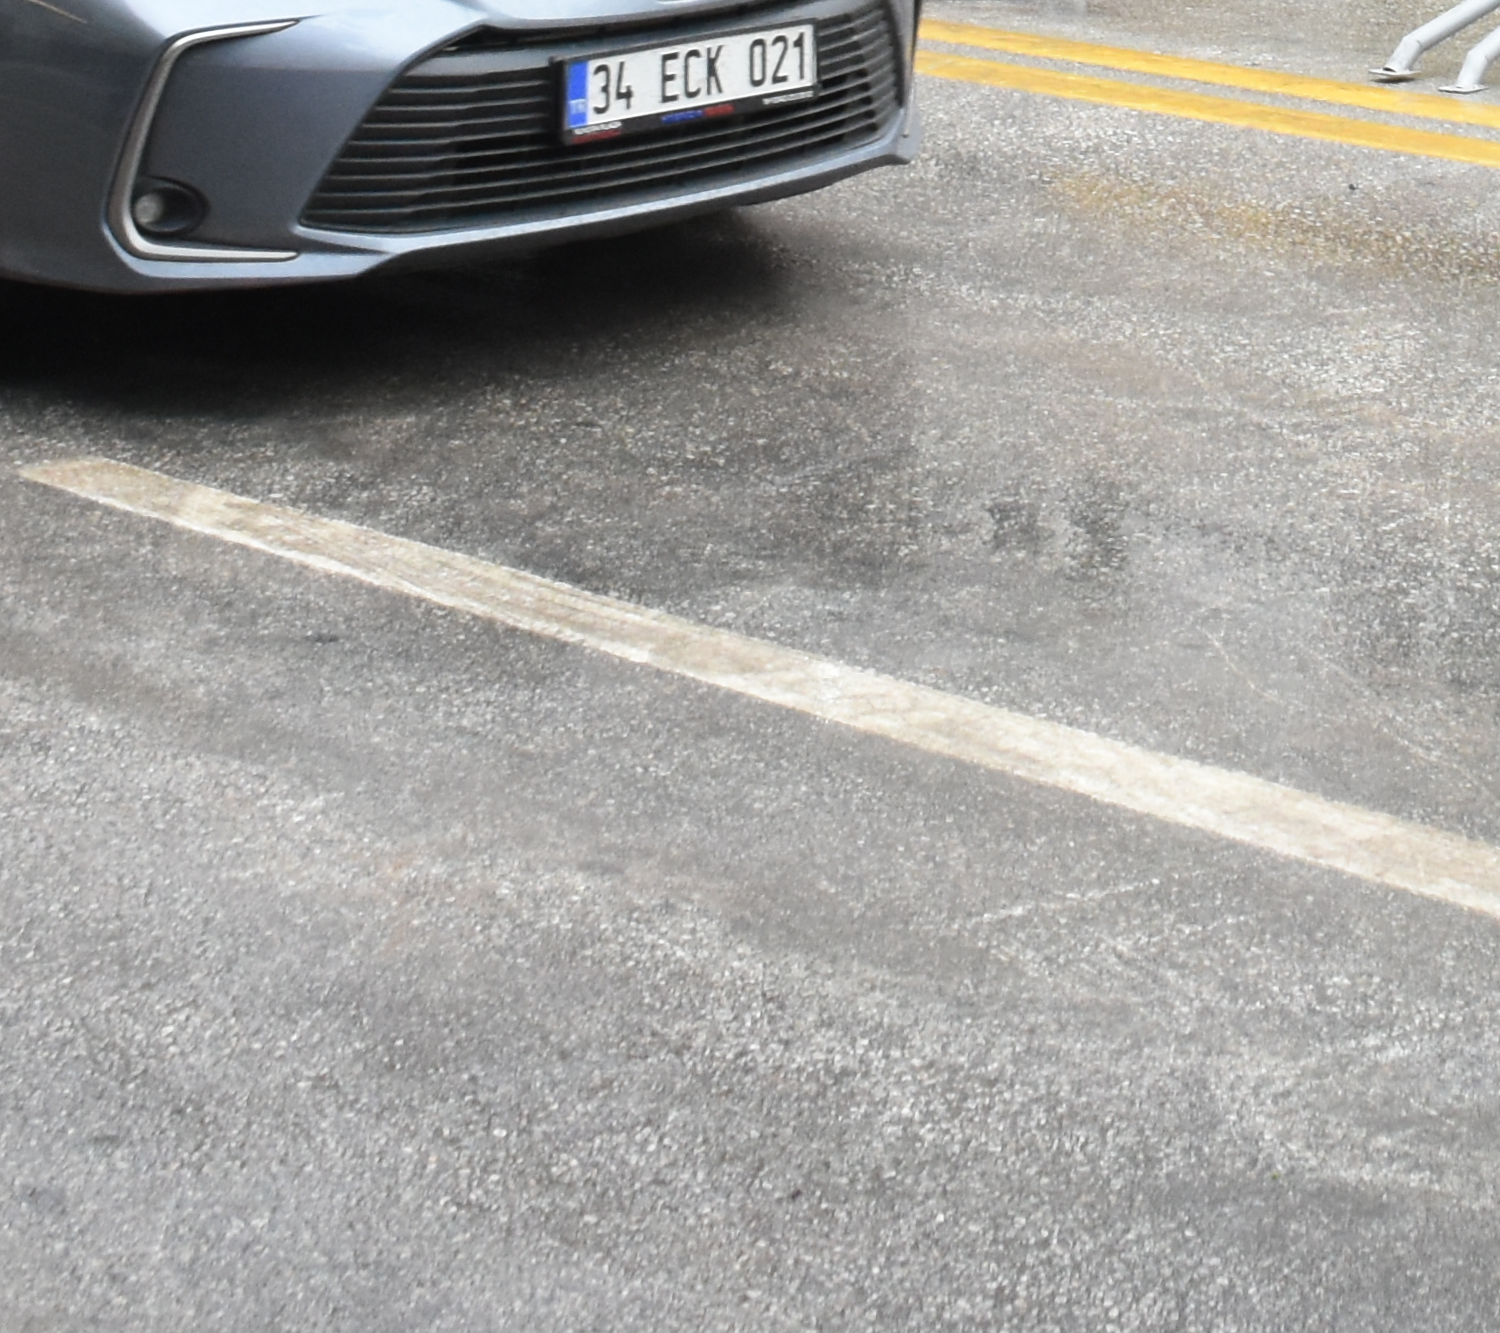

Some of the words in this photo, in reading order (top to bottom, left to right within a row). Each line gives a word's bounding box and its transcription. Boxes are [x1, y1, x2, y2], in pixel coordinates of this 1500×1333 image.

[592, 61, 633, 115] 34
[660, 44, 726, 104] ECK
[749, 31, 806, 87] 021
